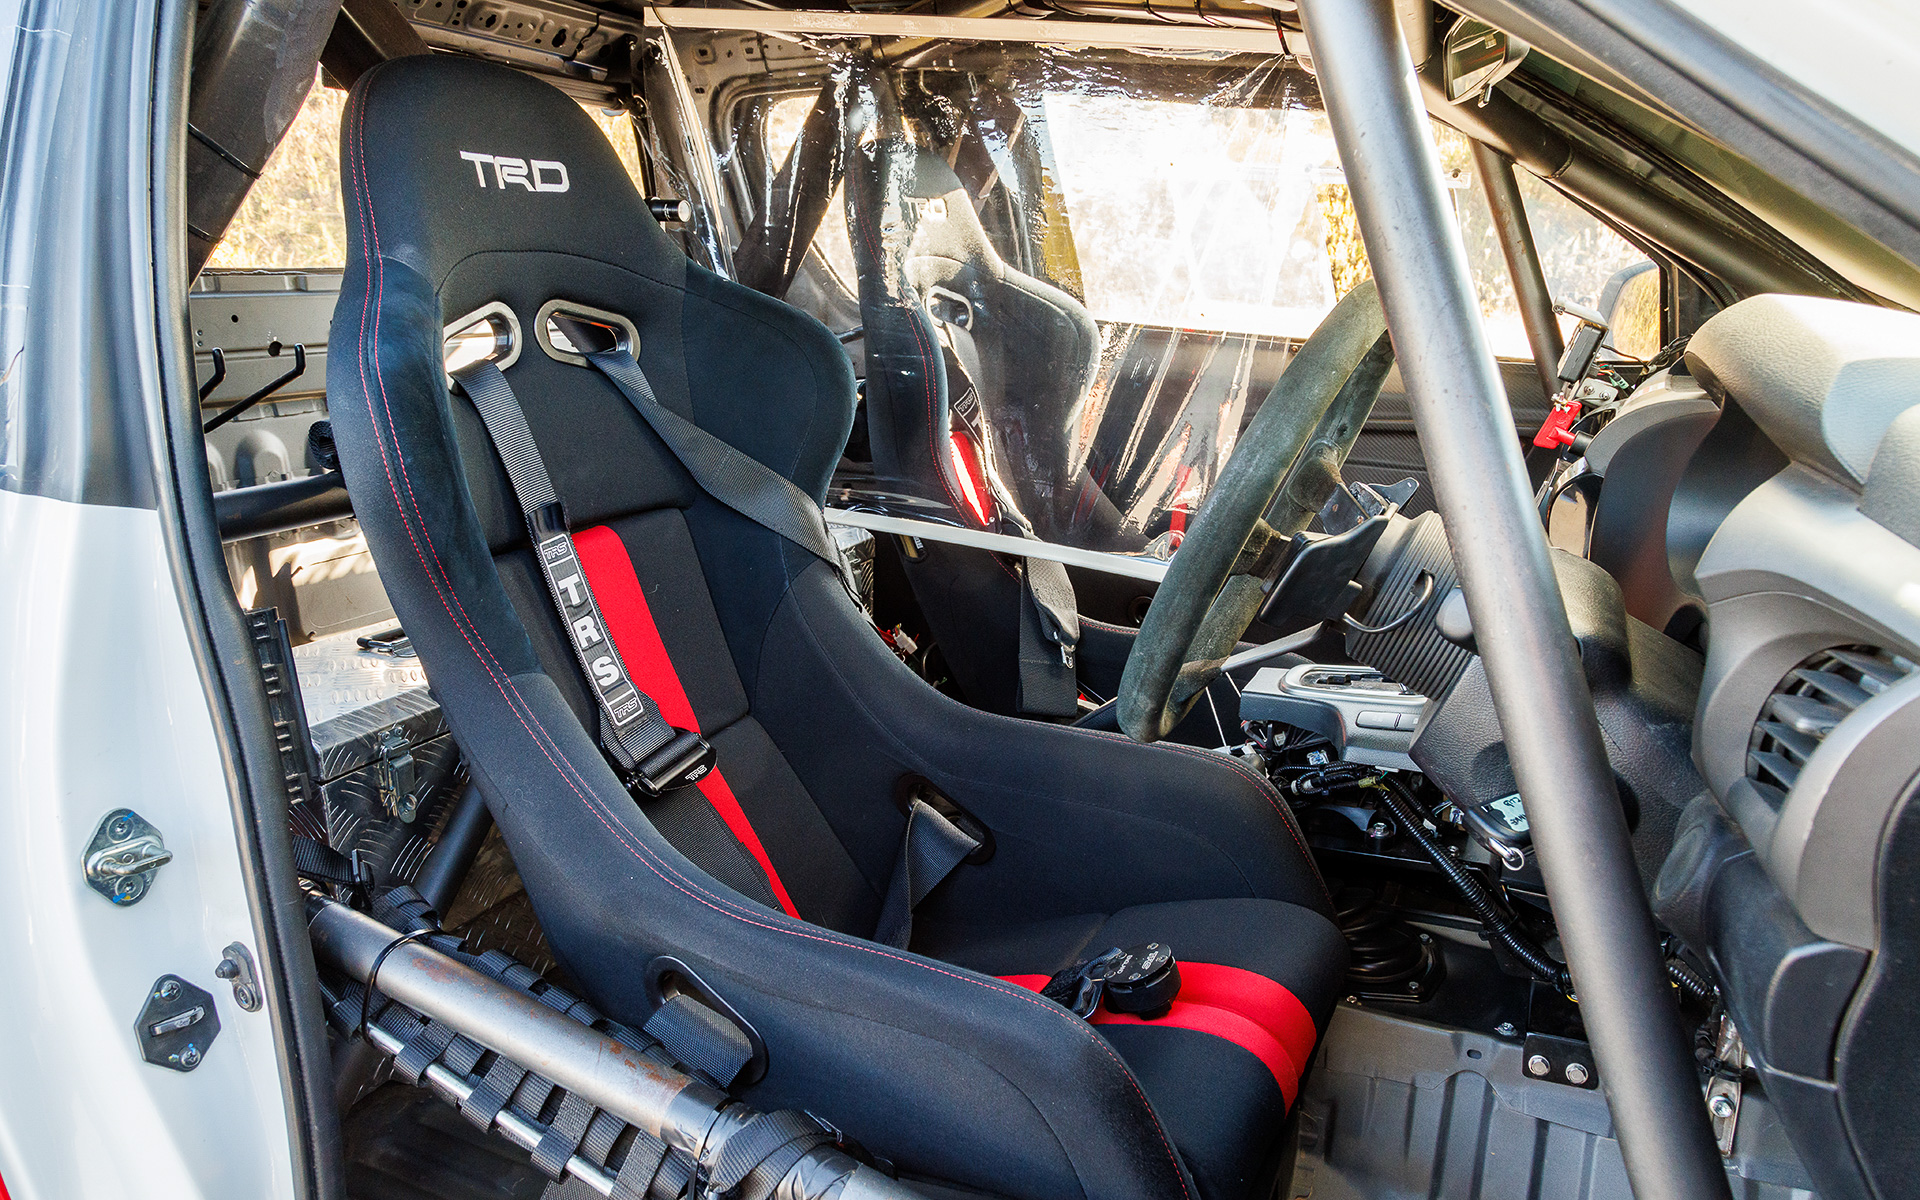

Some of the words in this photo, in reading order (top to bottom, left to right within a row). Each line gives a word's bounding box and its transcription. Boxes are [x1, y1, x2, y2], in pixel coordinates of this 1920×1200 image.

[459, 150, 570, 193] TRD
[902, 195, 949, 221] TRD
[544, 541, 568, 560] TRS
[557, 573, 620, 687] TRS
[614, 697, 638, 719] TRS
[685, 764, 708, 782] TRS
